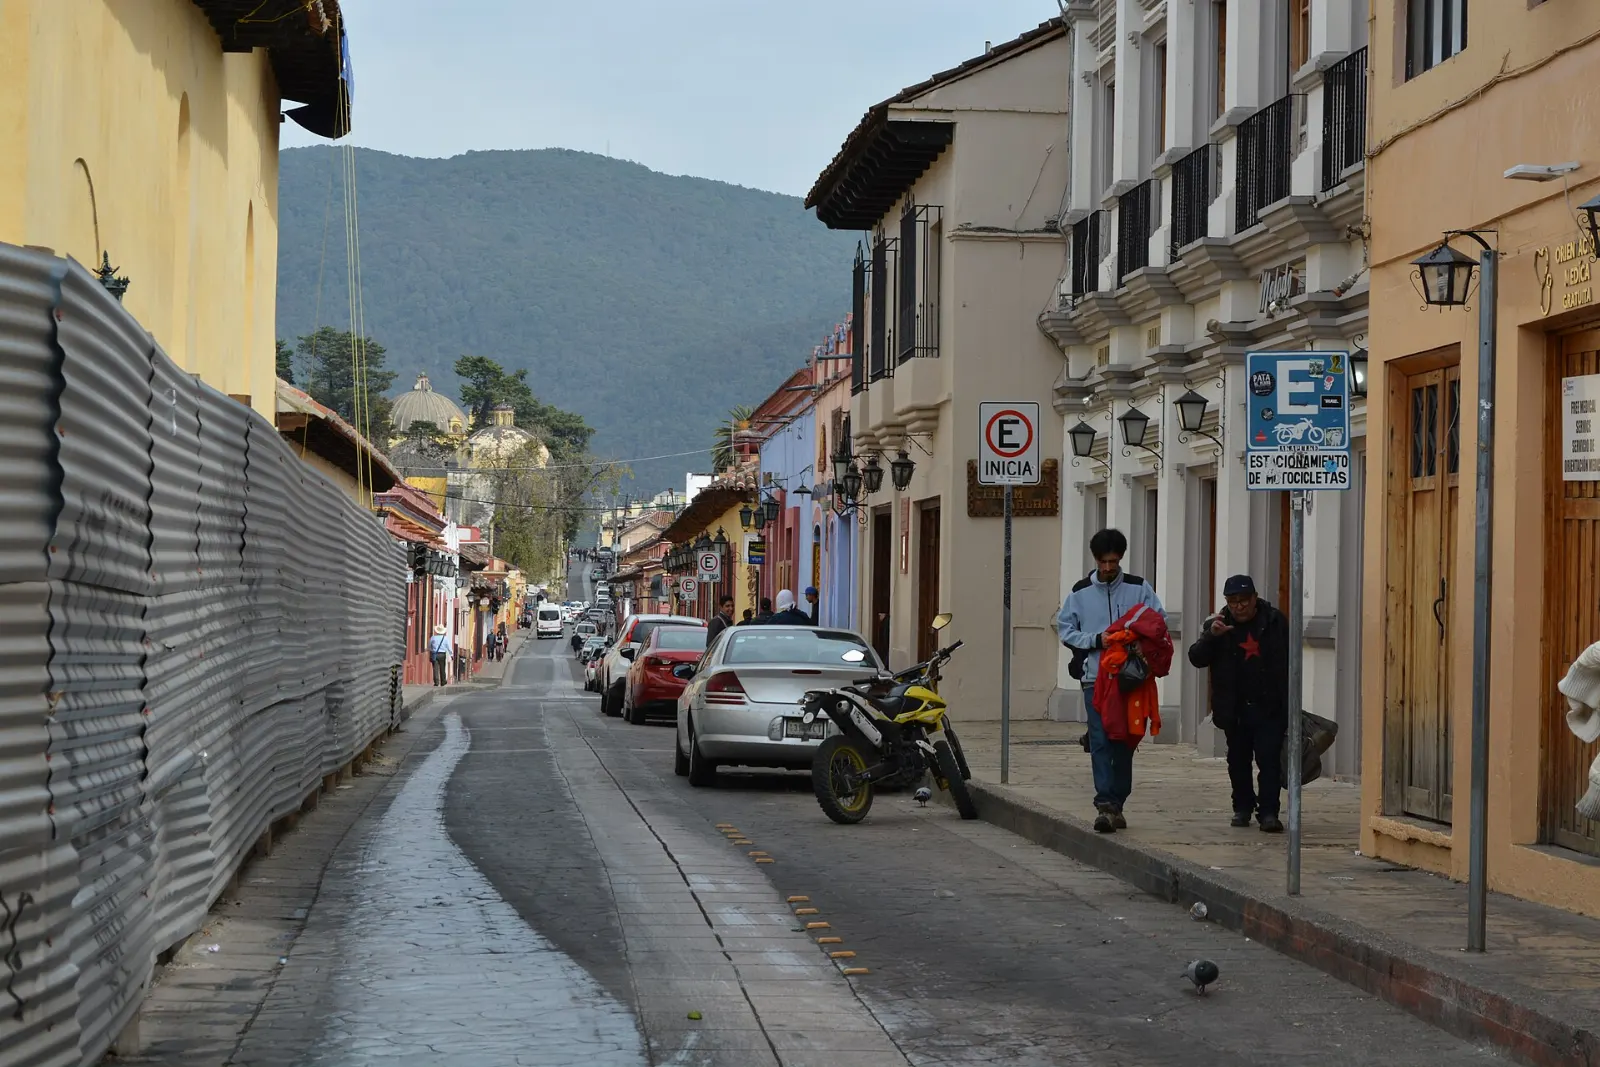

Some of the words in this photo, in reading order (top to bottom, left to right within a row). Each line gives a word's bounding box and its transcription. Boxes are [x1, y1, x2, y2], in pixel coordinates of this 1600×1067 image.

[1276, 360, 1319, 415] E
[1571, 401, 1580, 414] FREE
[1580, 400, 1597, 413] MEDICAL
[998, 419, 1020, 448] E
[1575, 420, 1592, 434] SERVICE
[986, 460, 1033, 476] INICIA
[1249, 472, 1261, 484] DE
[705, 557, 713, 568] E
[686, 581, 693, 590] E
